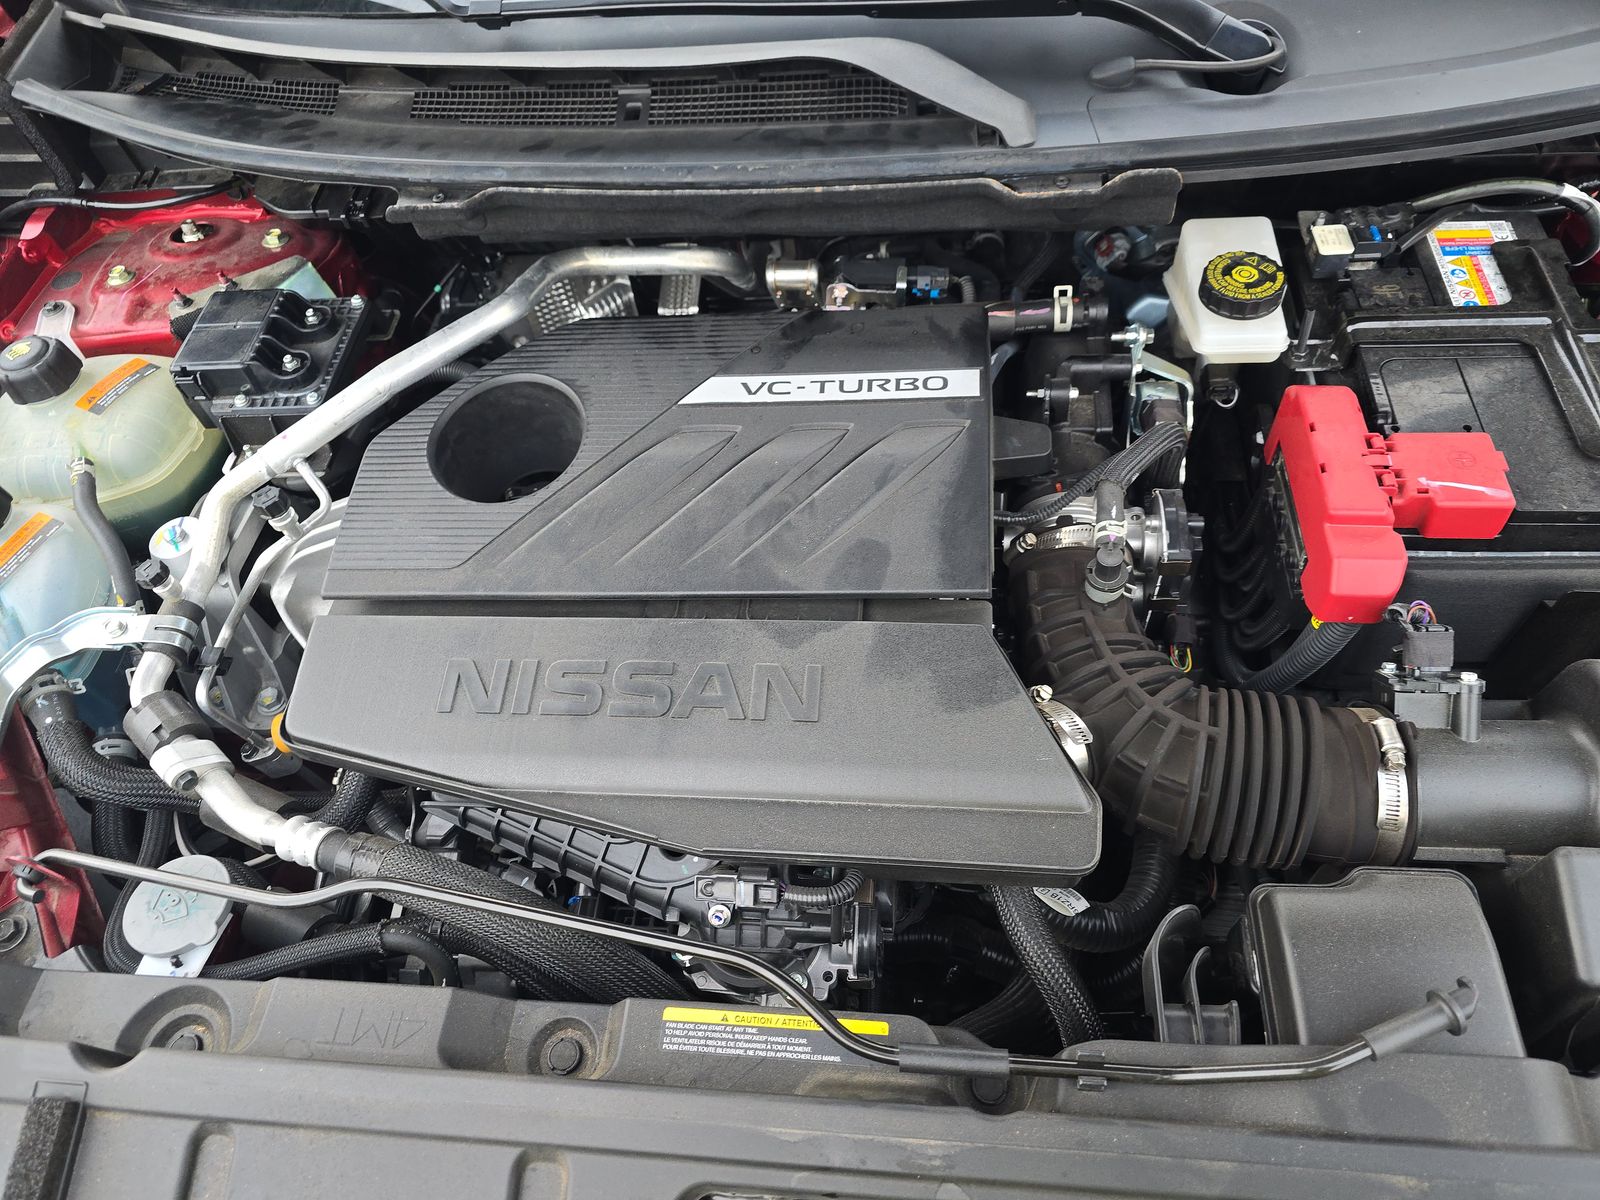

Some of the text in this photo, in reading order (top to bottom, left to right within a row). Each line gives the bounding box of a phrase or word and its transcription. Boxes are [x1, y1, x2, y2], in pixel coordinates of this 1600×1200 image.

[741, 376, 949, 395] VC-TURBO
[435, 658, 823, 722] NISSAN
[735, 1015, 772, 1025] CAUTION
[676, 1022, 694, 1030] BLADE
[705, 1031, 734, 1039] PERSONAL
[706, 1039, 726, 1047] RISQUE
[776, 1052, 811, 1060] APPROCHER
